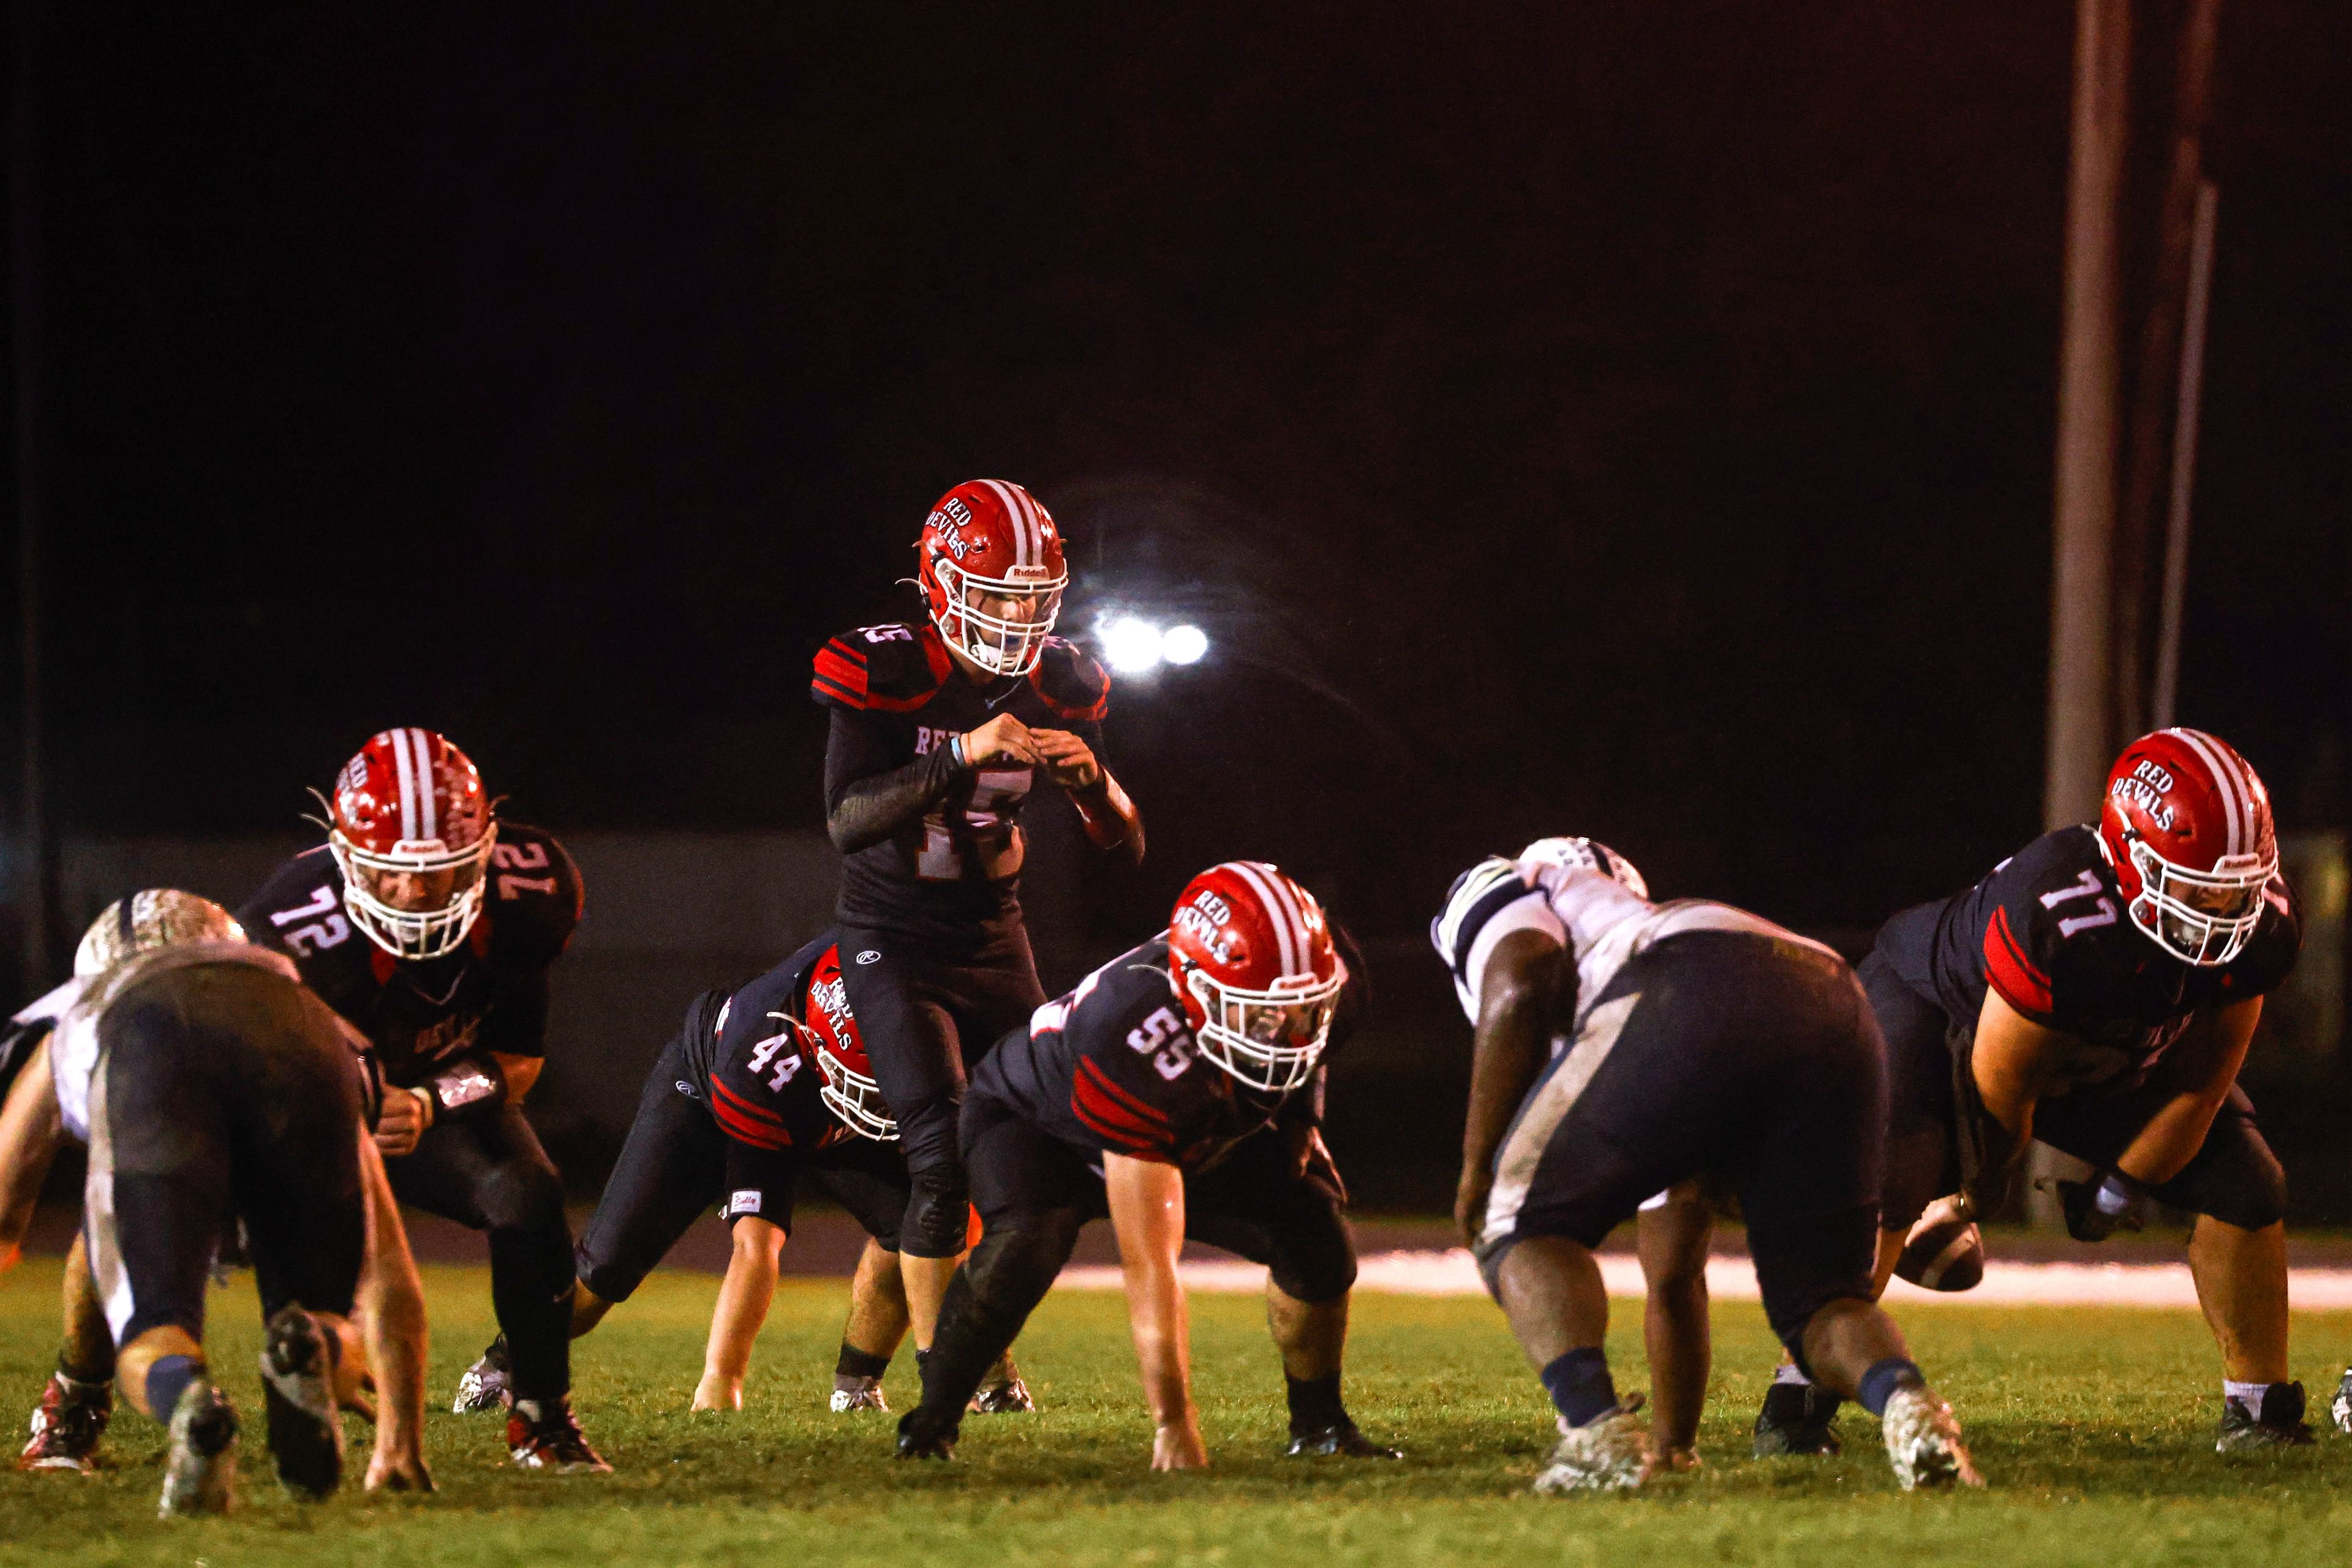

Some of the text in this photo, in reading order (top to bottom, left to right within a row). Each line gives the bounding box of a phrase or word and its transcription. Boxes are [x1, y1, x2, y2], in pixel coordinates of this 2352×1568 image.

[925, 511, 968, 560] DEVILS
[943, 497, 971, 526] RED
[916, 726, 961, 755] RE
[2111, 778, 2174, 831] DEVILS
[2133, 760, 2173, 794] RED
[494, 842, 556, 901] 72
[270, 885, 352, 958] 72
[1194, 890, 1231, 926] RED
[2039, 869, 2119, 940] 77
[1173, 907, 1229, 965] DEVILS
[810, 981, 852, 1050] DEVILS
[1127, 1007, 1193, 1080] 55
[747, 1033, 802, 1093] 44
